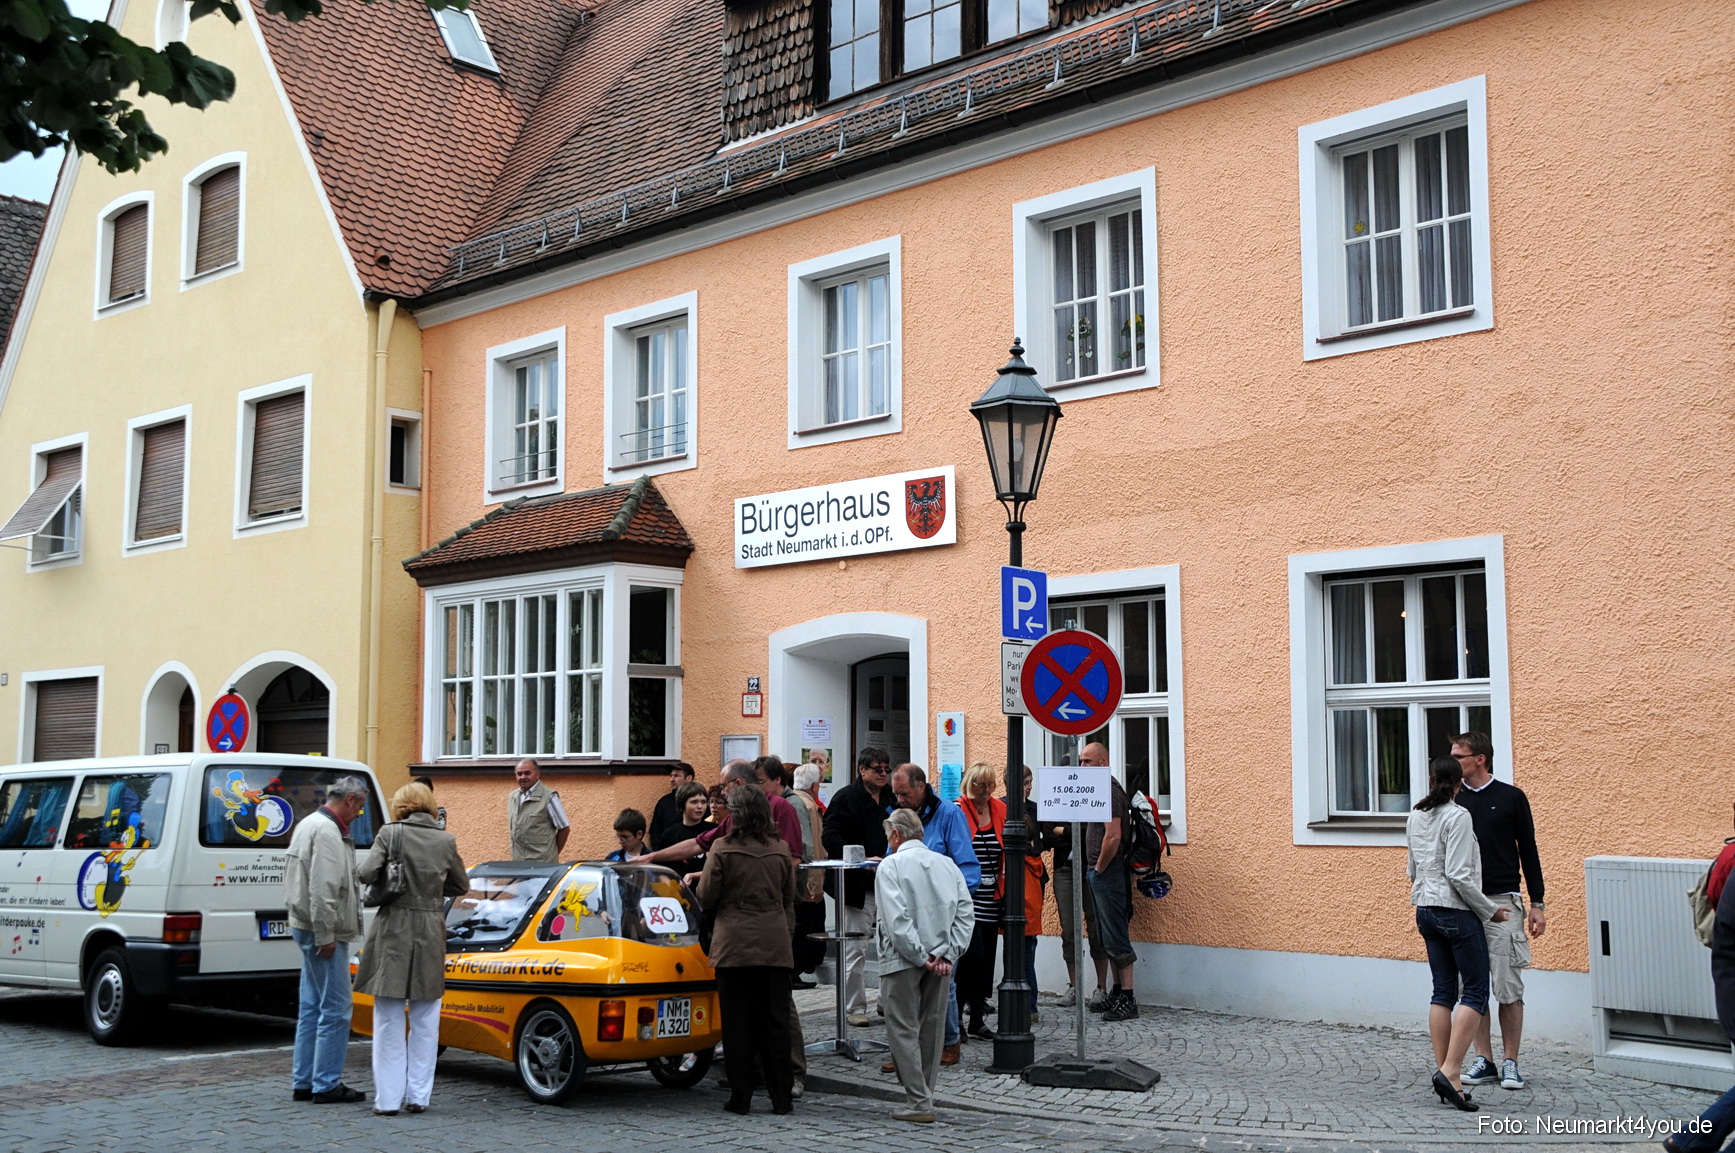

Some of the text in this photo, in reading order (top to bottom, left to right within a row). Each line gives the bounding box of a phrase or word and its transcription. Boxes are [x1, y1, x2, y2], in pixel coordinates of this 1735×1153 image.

[741, 490, 891, 538] Bürgerhaus
[741, 541, 773, 559] Stadt
[777, 533, 837, 555] Neumarkt
[1012, 577, 1037, 630] P
[1012, 651, 1024, 659] nur
[748, 678, 759, 690] 22
[1006, 699, 1015, 708] Sa
[1052, 785, 1095, 794] 15.06.2008
[1090, 800, 1106, 808] Uhr
[228, 873, 283, 883] www.irmi
[29, 897, 48, 905] Kindern
[269, 922, 285, 935] RD
[445, 1002, 476, 1012] zeitgemäße
[477, 1003, 505, 1014] Mobilität
[667, 1001, 682, 1017] NM
[658, 1018, 690, 1035] A 320
